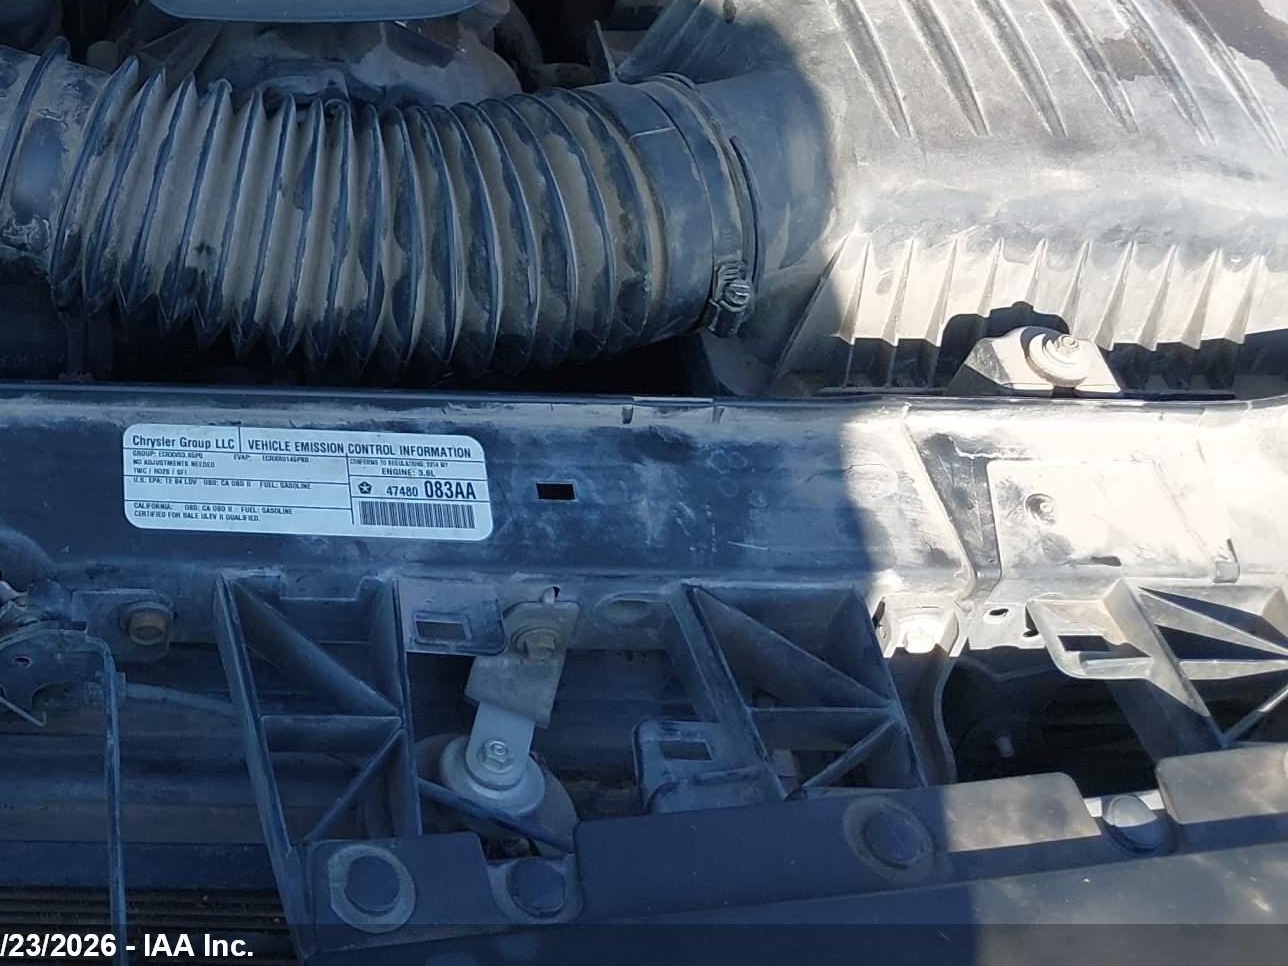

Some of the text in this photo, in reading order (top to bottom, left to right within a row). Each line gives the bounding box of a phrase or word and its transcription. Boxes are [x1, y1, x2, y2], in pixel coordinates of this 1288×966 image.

[132, 435, 235, 450] Chrysler Group LLC
[248, 440, 472, 458] VEHICLE EMISSION CONTROL INFORMATION
[382, 468, 416, 476] ENGINE:
[386, 481, 476, 499] 47480 083AA
